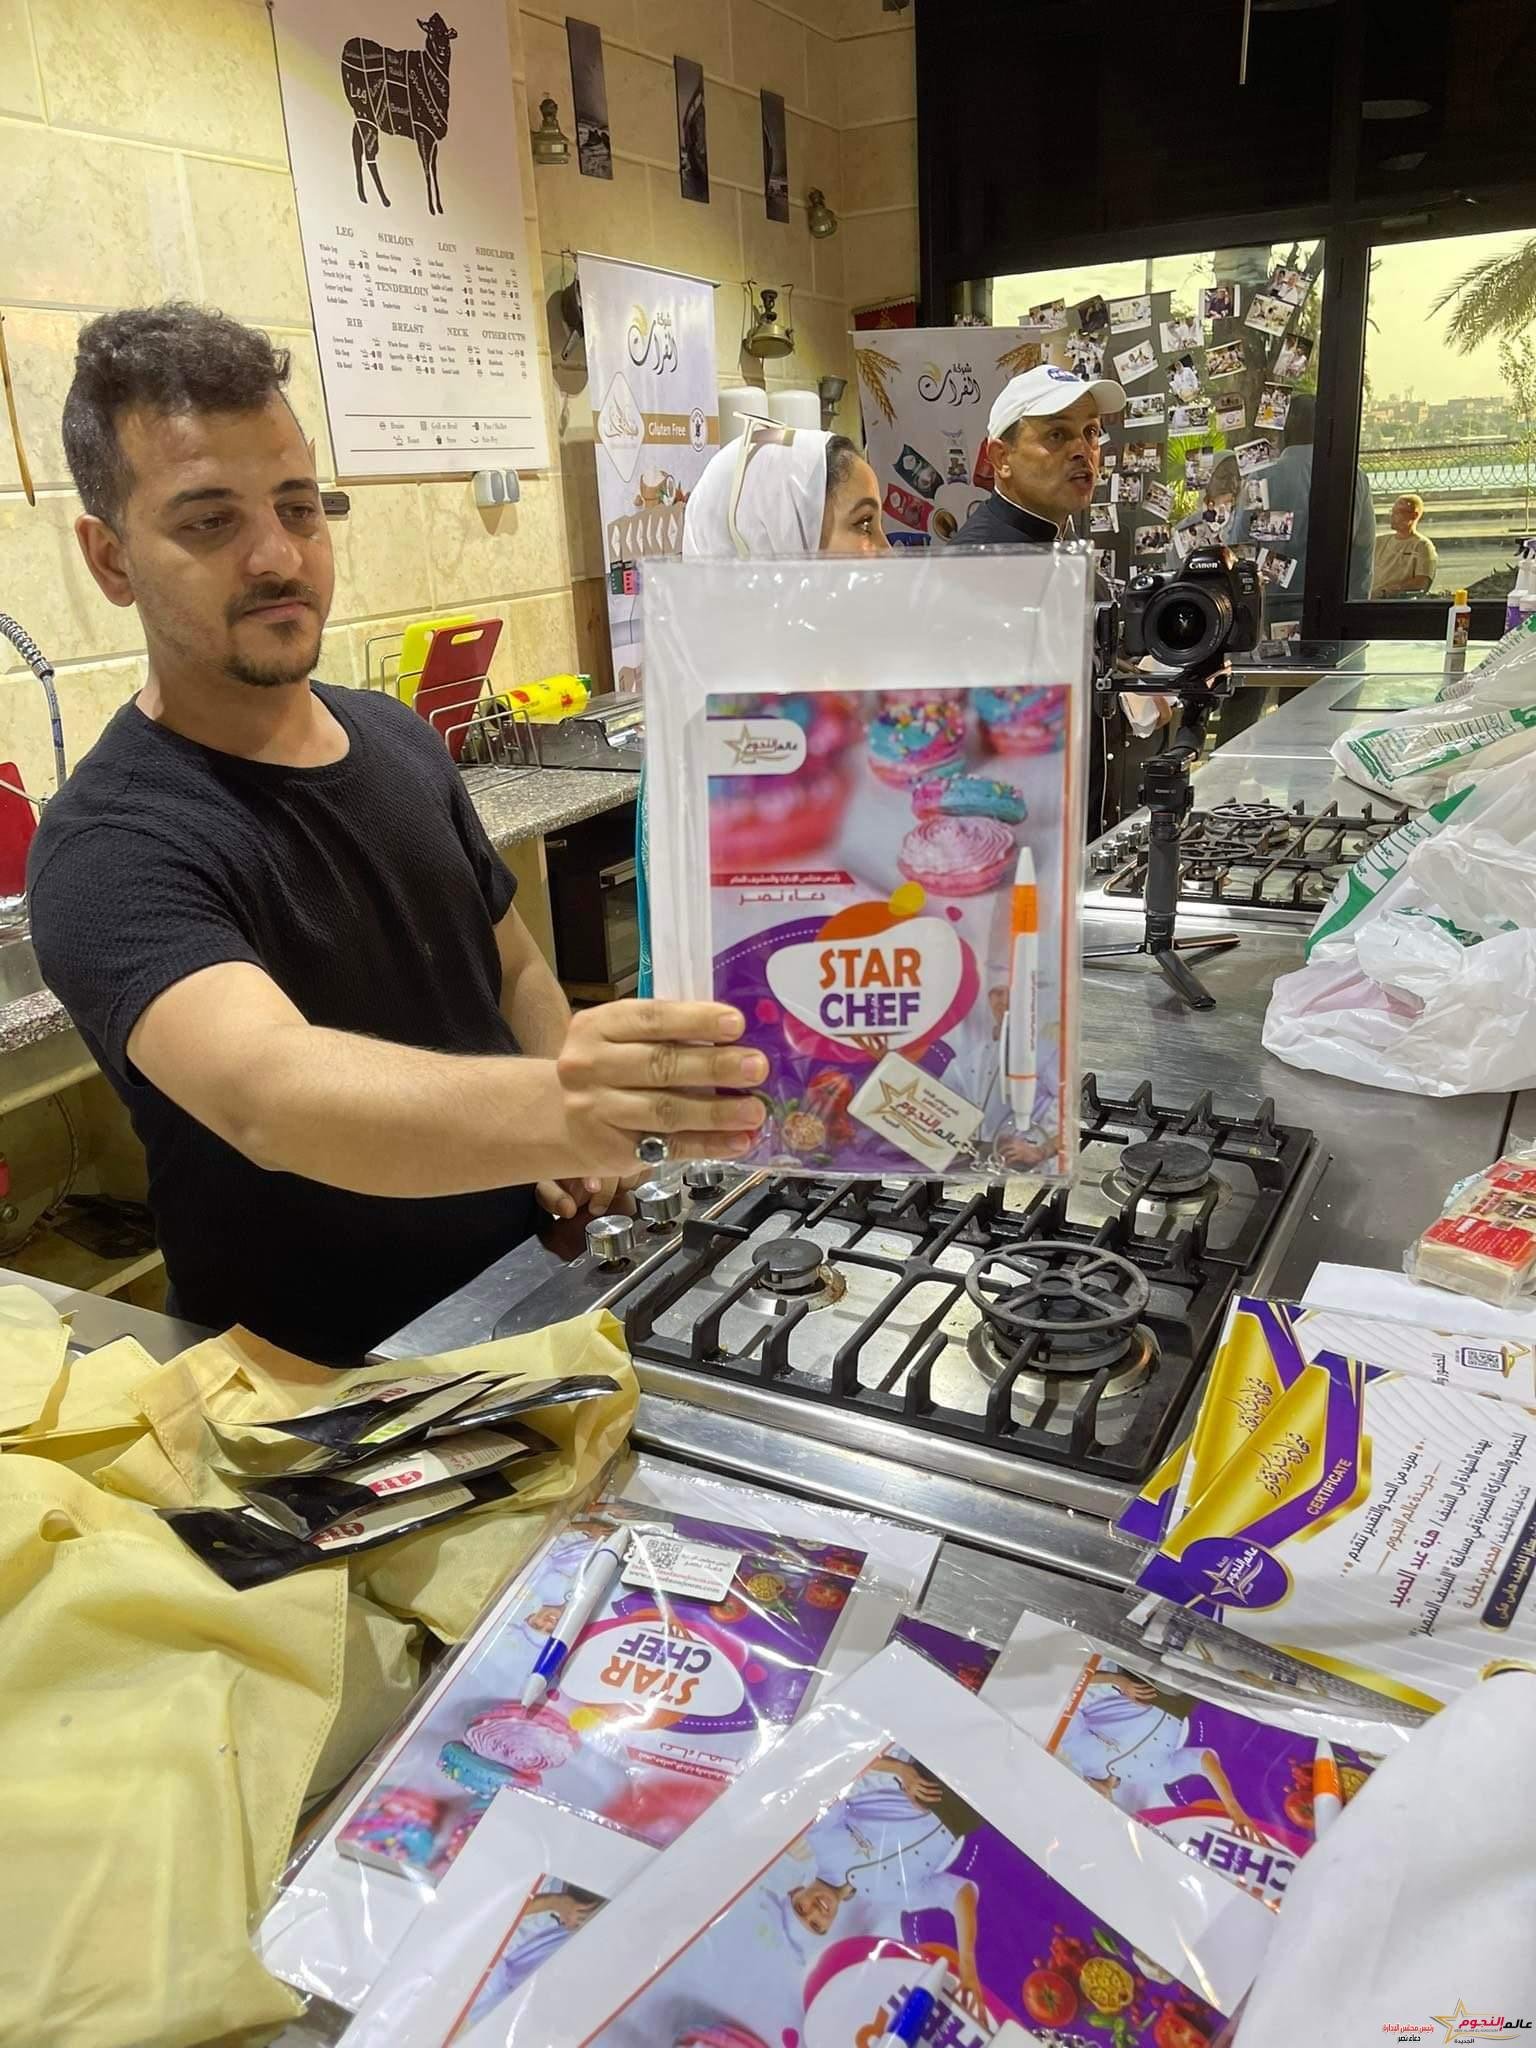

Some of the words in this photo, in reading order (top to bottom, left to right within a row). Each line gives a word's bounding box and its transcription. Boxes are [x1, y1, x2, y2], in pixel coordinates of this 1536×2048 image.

[336, 226, 354, 238] LEG
[378, 232, 414, 247] SIRLOIN
[375, 281, 429, 297] TENDERLOIN
[346, 317, 363, 328] RIB
[392, 322, 424, 333] BREAST
[447, 327, 469, 337] NECK
[482, 330, 506, 340] OTHER
[507, 332, 527, 341] CUTS
[952, 363, 972, 375] شركة
[918, 369, 981, 407] الفرات
[648, 422, 671, 437] Gluten
[672, 423, 687, 437] Free
[1188, 561, 1219, 570] Canon
[819, 948, 922, 990] STAR
[820, 992, 921, 1029] CHEF
[1306, 1458, 1352, 1516] CERTIFICATE
[1383, 1482, 1400, 1504] الحب
[1414, 1530, 1441, 1548] هبة
[1410, 1551, 1430, 1570] عبد
[1479, 1547, 1502, 1579] محمود
[1390, 1569, 1417, 1608] الحميد
[617, 1634, 712, 1674] CHEF
[600, 1655, 700, 1706] STAR
[1187, 1831, 1296, 1892] CHEF
